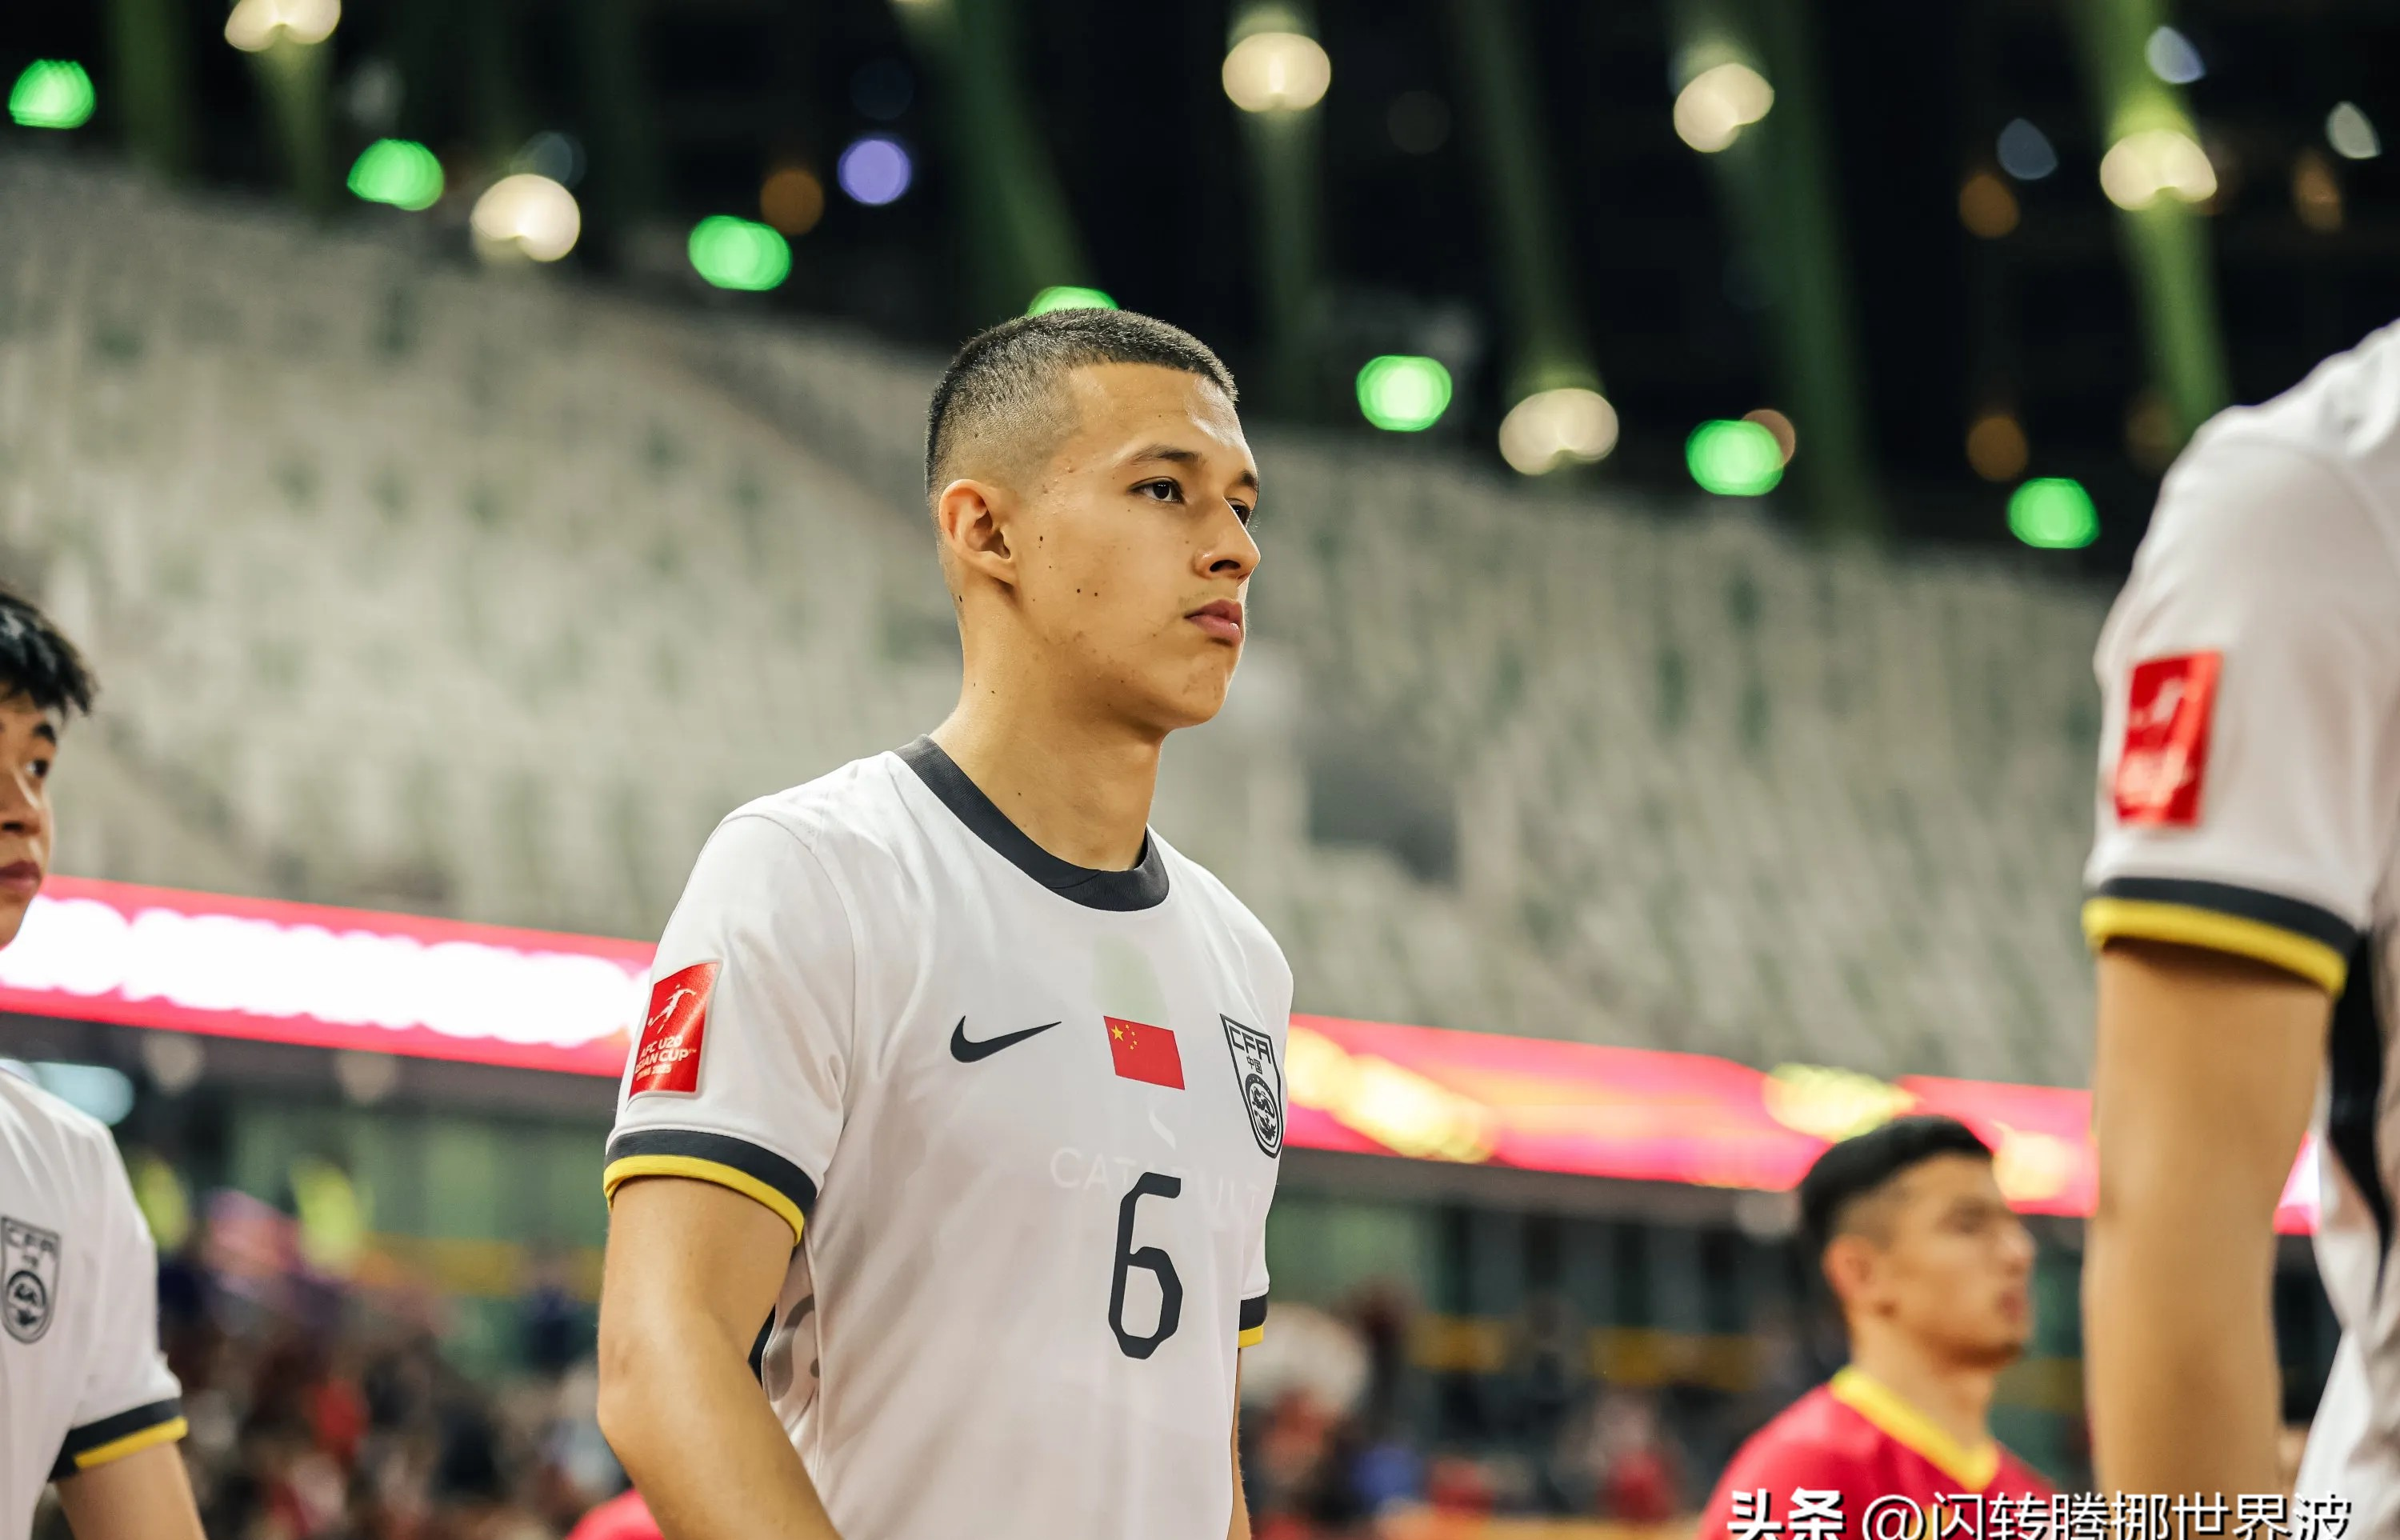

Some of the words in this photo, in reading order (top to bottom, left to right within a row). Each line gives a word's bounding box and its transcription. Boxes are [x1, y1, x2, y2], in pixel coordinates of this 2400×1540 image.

[658, 1034, 684, 1050] U20
[1229, 1025, 1272, 1065] CFA
[1246, 1055, 1262, 1074] 中国
[1108, 1171, 1183, 1360] 6
